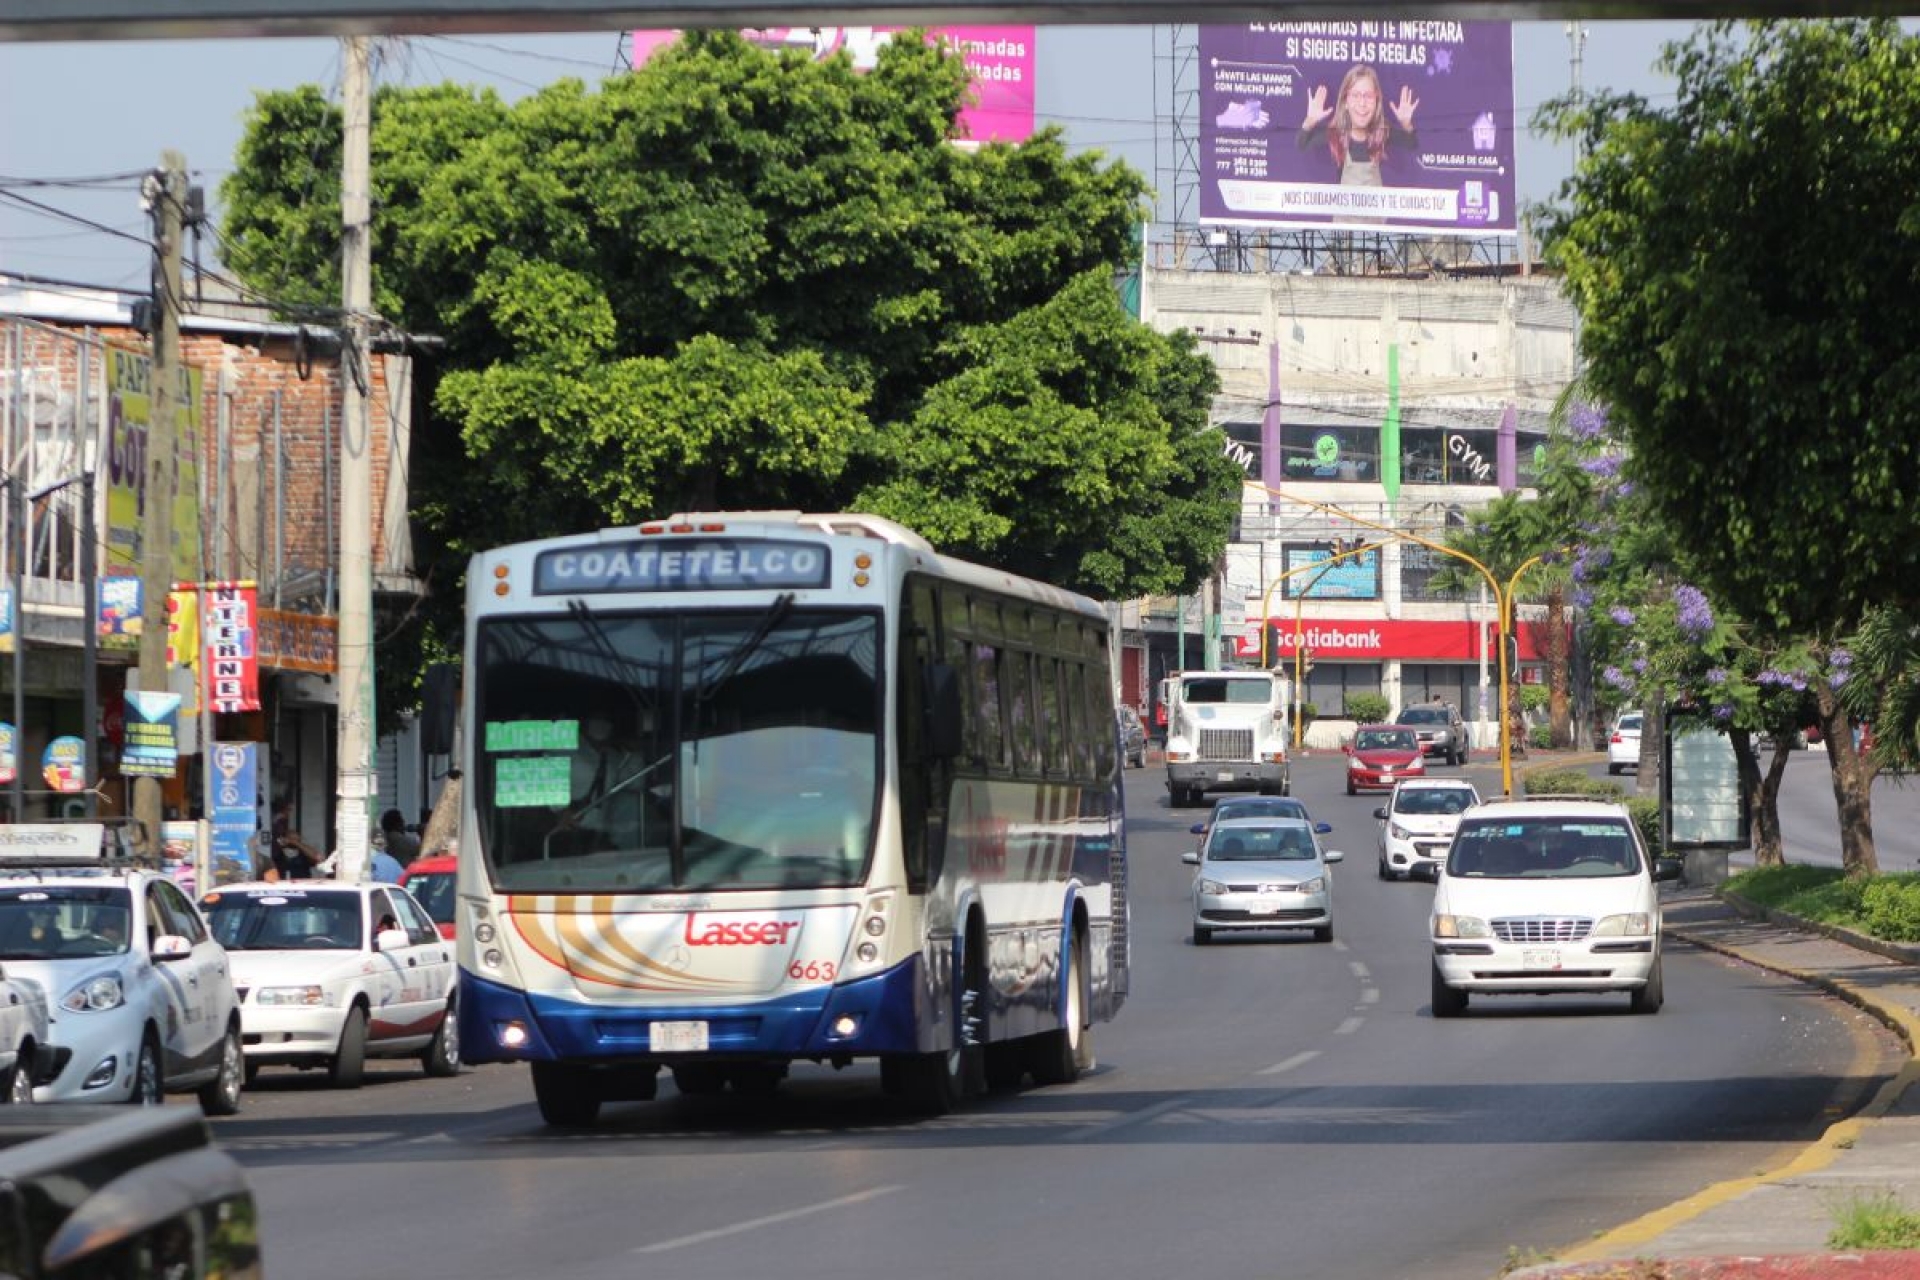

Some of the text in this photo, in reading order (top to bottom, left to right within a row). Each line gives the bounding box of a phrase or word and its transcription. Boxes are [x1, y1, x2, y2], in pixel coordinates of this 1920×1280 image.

[1285, 37, 1428, 65] SI SIGUES LAS REGLAS
[1422, 153, 1436, 164] NO
[1478, 156, 1498, 166] CASA
[1303, 191, 1350, 207] CUIDAMOS
[1350, 193, 1379, 208] TODOS
[1380, 194, 1387, 208] Y
[1400, 195, 1431, 209] CUIDAS
[1223, 436, 1254, 471] YM
[1449, 434, 1490, 479] GYM
[553, 549, 817, 578] COATETELCO
[684, 911, 799, 946] Lasser
[789, 960, 836, 982] 663
